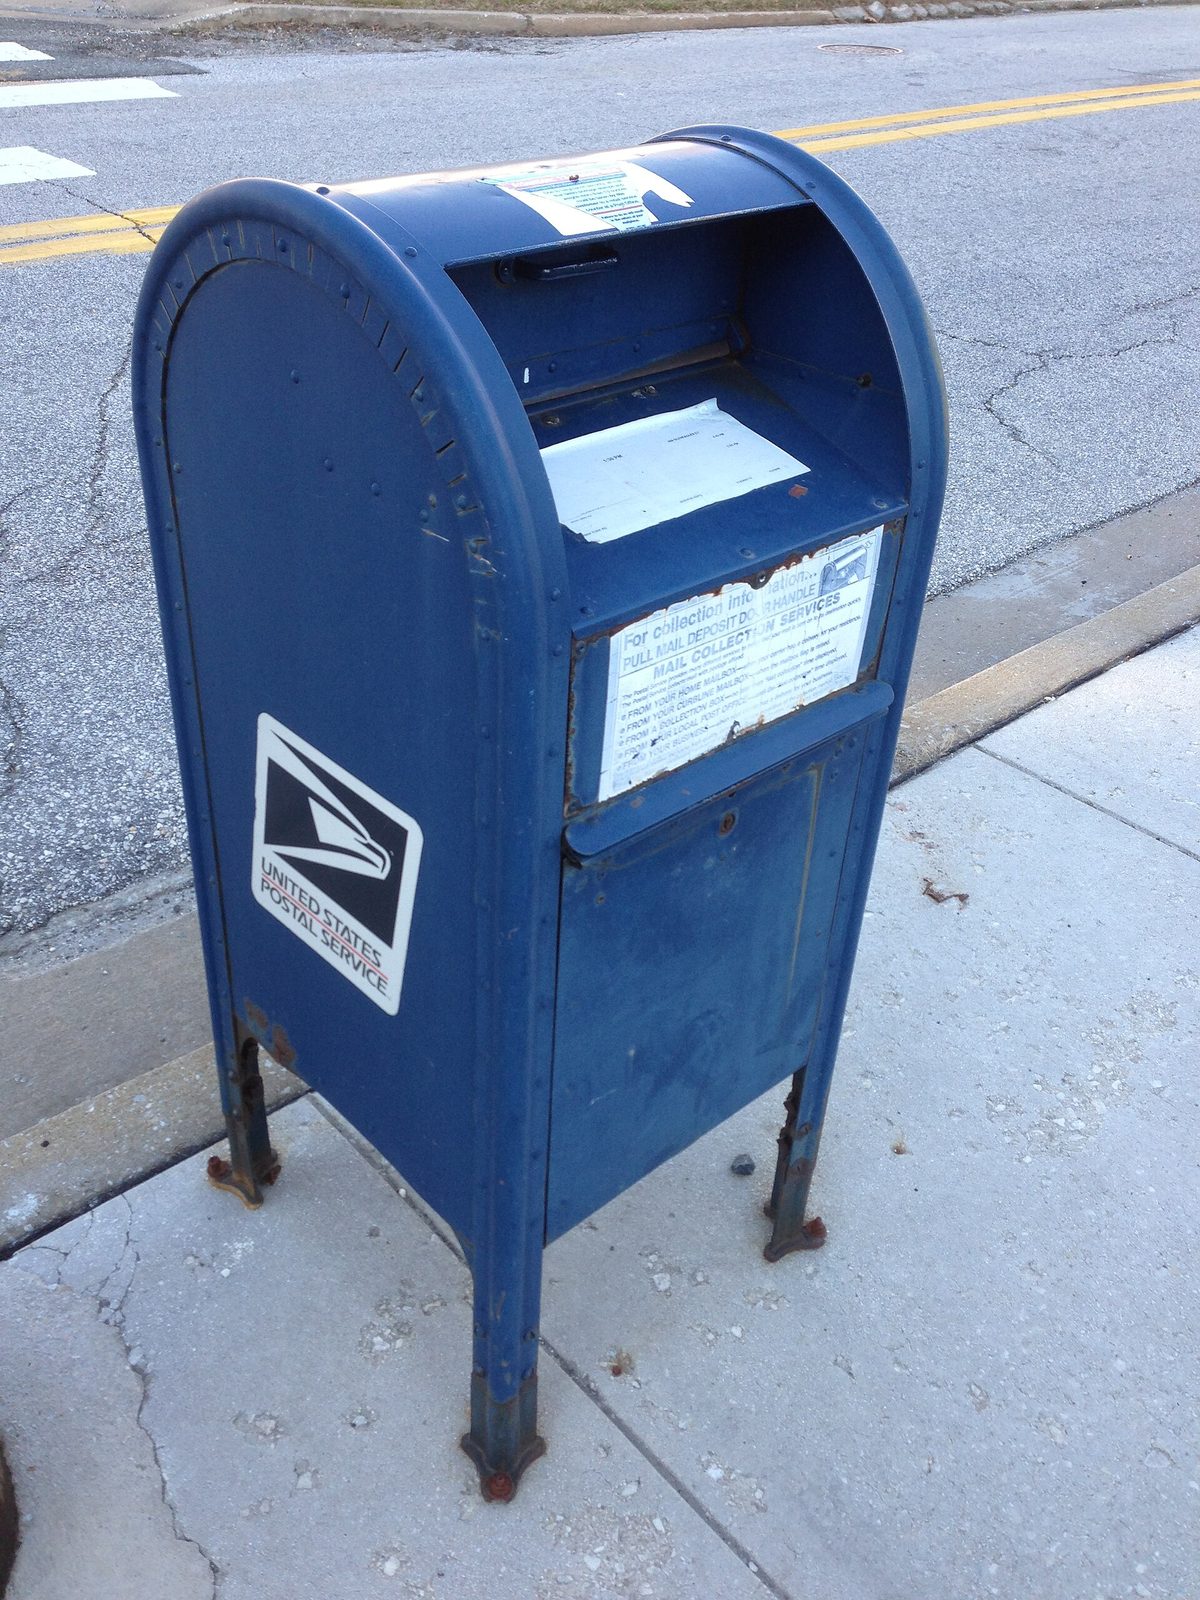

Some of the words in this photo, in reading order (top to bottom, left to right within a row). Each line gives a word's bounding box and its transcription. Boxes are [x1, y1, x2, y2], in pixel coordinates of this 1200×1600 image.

[623, 626, 648, 651] For
[652, 596, 723, 642] collection
[623, 646, 653, 671] PULL
[656, 633, 685, 658] MAIL
[687, 613, 736, 646] DEPOSIT
[772, 581, 816, 611] HANDLE
[653, 653, 687, 680] MAIL
[779, 589, 841, 628] SERVICES
[625, 727, 648, 746] FROM
[651, 723, 657, 733] A
[659, 701, 707, 731] COLLECTION
[626, 714, 650, 733] FROM
[652, 703, 674, 721] YOUR
[627, 701, 651, 720] FROM
[654, 690, 676, 708] YOUR
[677, 680, 702, 698] HOME
[673, 716, 699, 736] LOCAL
[700, 707, 720, 723] POST
[261, 856, 320, 916] UNITED
[323, 908, 382, 969] STATES
[261, 877, 318, 938] POSTAL
[321, 929, 389, 998] SERVICE
